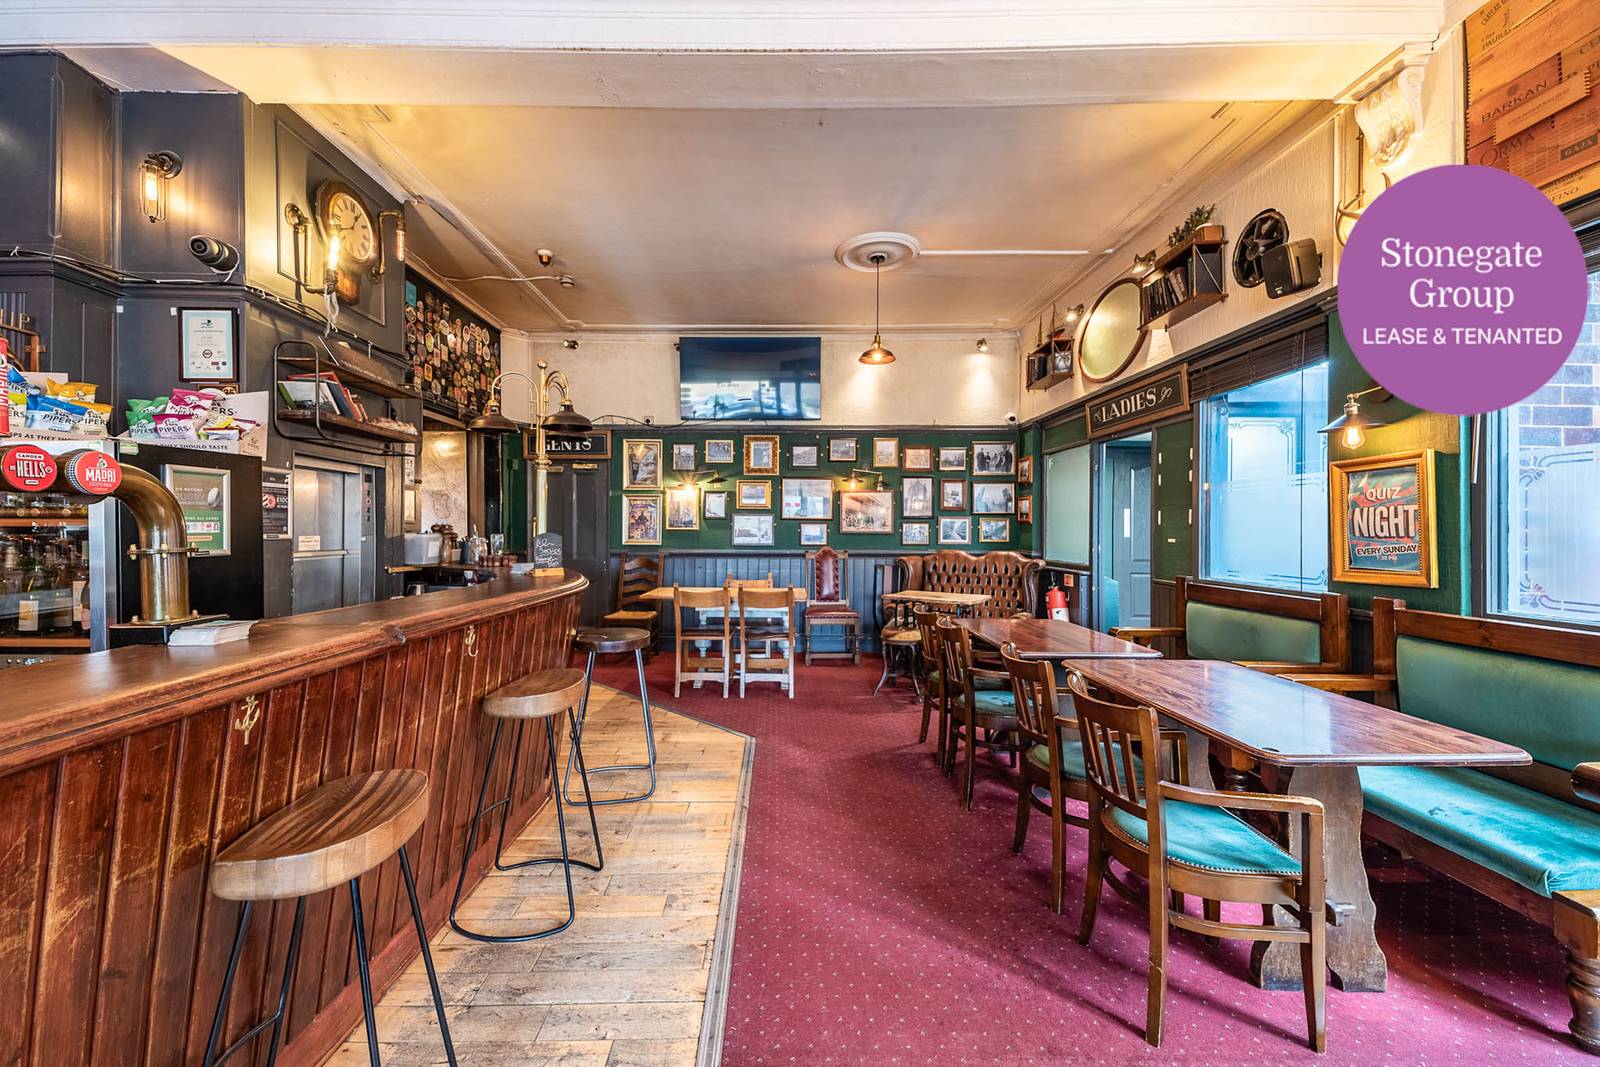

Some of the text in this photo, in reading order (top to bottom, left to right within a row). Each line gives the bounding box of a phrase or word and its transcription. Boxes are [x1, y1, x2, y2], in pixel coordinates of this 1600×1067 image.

[1482, 80, 1547, 123] BARKAN
[1101, 387, 1158, 423] LADIES
[158, 425, 190, 434] PIPERS
[16, 460, 46, 478] HELLS
[85, 467, 117, 483] MADRI
[1365, 486, 1401, 502] QUIZ
[1353, 504, 1419, 538] NIGHT
[1356, 544, 1417, 556] EVERY SUNDAY
